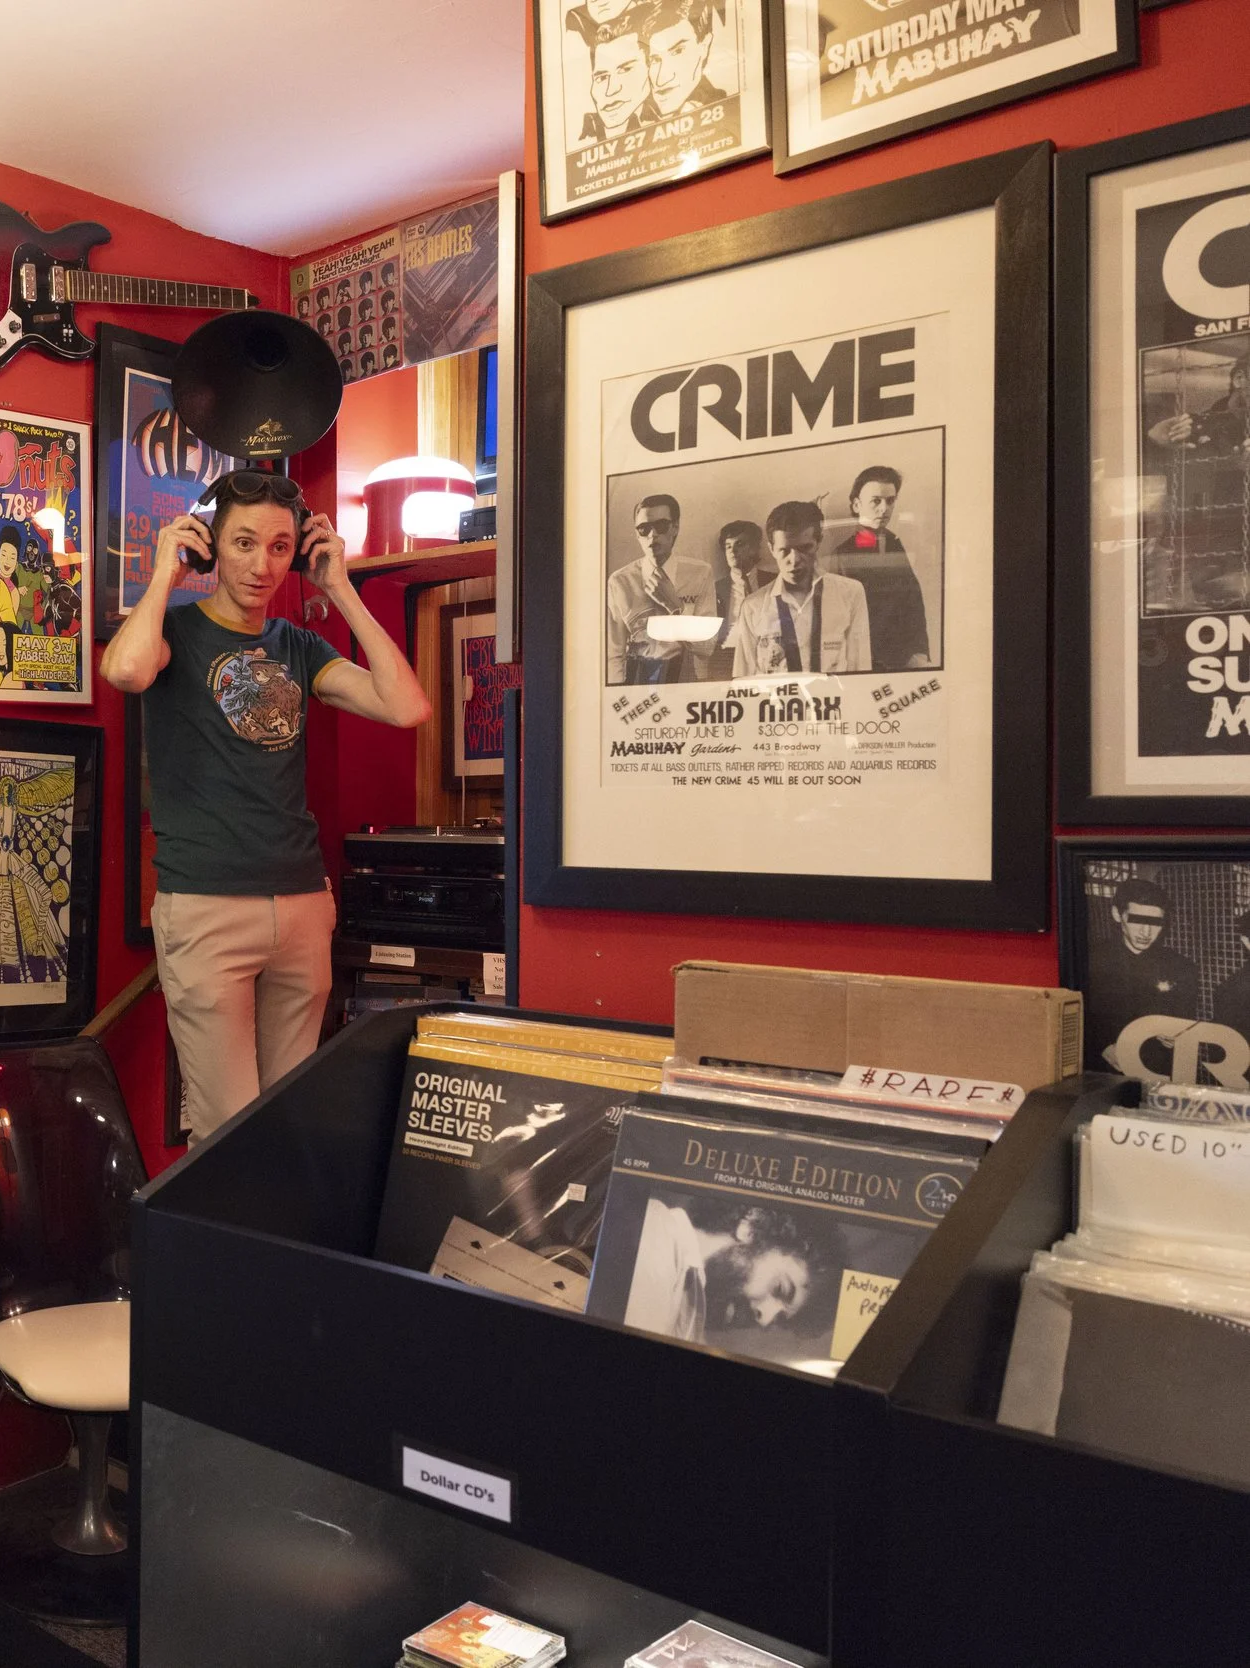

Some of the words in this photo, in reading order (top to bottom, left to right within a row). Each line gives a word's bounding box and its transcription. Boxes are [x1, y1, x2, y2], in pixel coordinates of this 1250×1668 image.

[827, 3, 957, 74] SATURDAY
[851, 9, 1041, 104] MABUHAY
[700, 105, 725, 126] 28
[576, 140, 618, 168] JULY
[624, 131, 647, 152] 27
[652, 117, 694, 142] AND
[574, 177, 614, 196] TICKETS
[617, 171, 628, 183] AT
[630, 165, 648, 179] ALL
[328, 244, 364, 262] BEATLES
[1194, 319, 1231, 338] SAN
[630, 326, 915, 454] CRIME
[17, 636, 51, 650] MAY
[612, 695, 630, 714] BE
[726, 686, 758, 699] AND
[871, 683, 894, 702] BE
[878, 678, 942, 719] SQUARE
[620, 691, 661, 726] THERE
[652, 705, 671, 724] OR
[686, 700, 744, 725] SKID
[634, 726, 690, 741] SATURDAY
[693, 725, 720, 739] JUNE
[723, 725, 734, 738] 18
[827, 721, 850, 736] THE
[855, 719, 901, 735] DOOR
[753, 742, 770, 751] 443
[775, 742, 821, 752] Broadway
[611, 762, 639, 772] TICKETS
[651, 762, 663, 772] ALL
[665, 762, 686, 772] BASS
[725, 761, 755, 771] RATHER
[757, 761, 785, 771] RIPPED
[787, 760, 825, 771] RECORDS
[827, 760, 847, 770] AND
[850, 760, 893, 770] AQUARIUS
[896, 759, 937, 770] RECORDS
[672, 776, 687, 785] THE
[691, 776, 712, 785] NEW
[715, 776, 742, 785] CRIME
[747, 776, 760, 785] 45
[763, 776, 784, 785] WILL
[788, 776, 799, 785] BE
[802, 776, 824, 785] OUT
[827, 775, 862, 785] SOON
[415, 1071, 507, 1104] ORIGINAL
[410, 1090, 492, 1122] MASTER
[407, 1110, 494, 1143] SLEEVES
[1110, 1124, 1187, 1155] USED
[622, 1158, 633, 1167] 45
[633, 1159, 650, 1170] RPM
[683, 1138, 781, 1182] DELUXE
[790, 1155, 902, 1201] EDITION
[713, 1173, 737, 1186] FROM
[738, 1176, 753, 1188] THE
[754, 1178, 794, 1196] ORIGINAL
[795, 1186, 831, 1201] ANALOG
[832, 1190, 866, 1207] MASTER
[420, 1468, 461, 1494] Dollar
[464, 1482, 495, 1504] CD's
